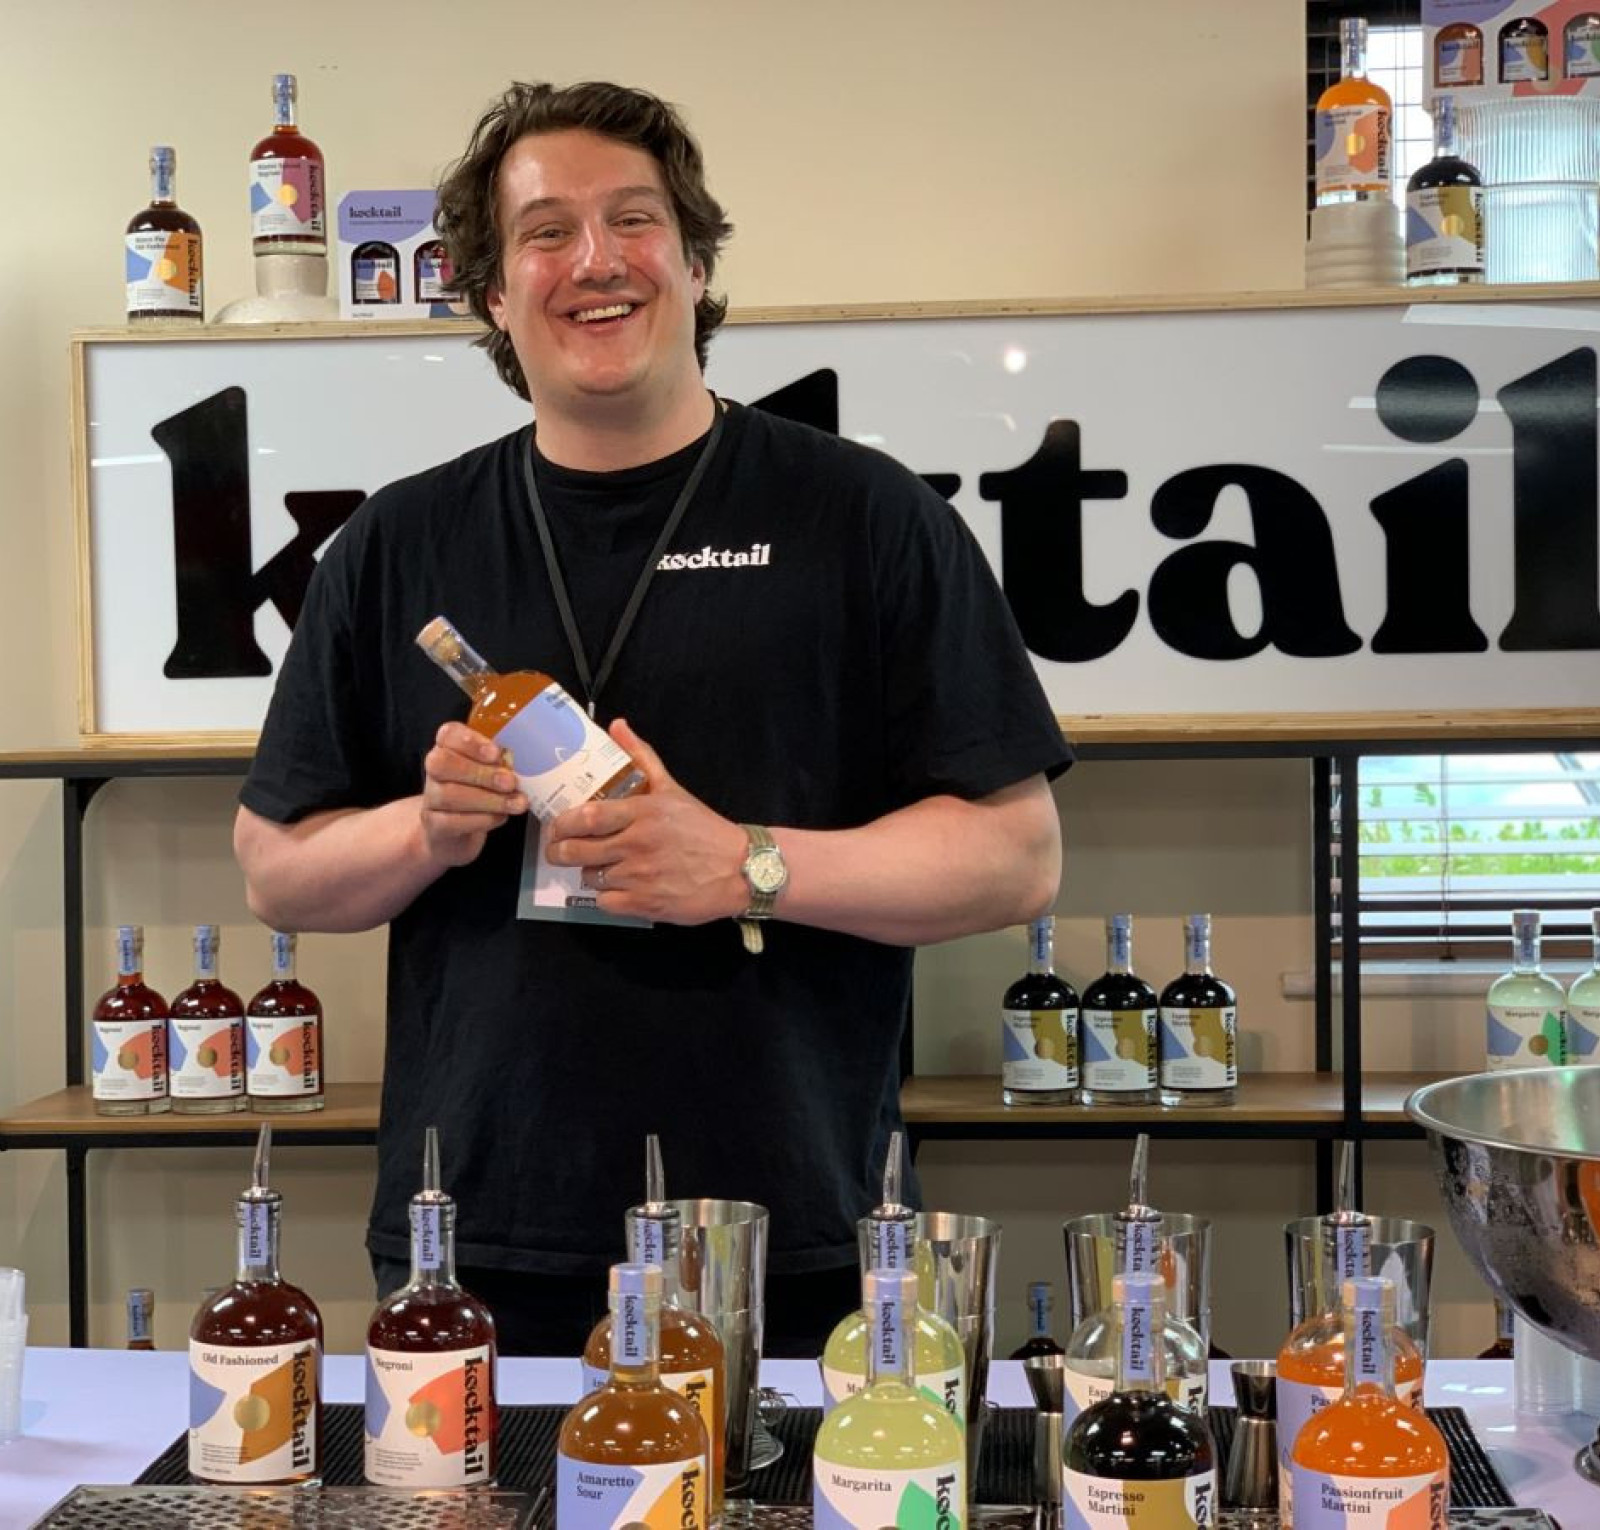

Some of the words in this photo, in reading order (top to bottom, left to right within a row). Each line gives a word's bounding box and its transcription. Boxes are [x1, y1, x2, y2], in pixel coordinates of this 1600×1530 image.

[203, 1351, 218, 1364] Old
[220, 1353, 279, 1367] Fashioned
[376, 1357, 414, 1371] Negroni
[577, 1471, 635, 1488] Amaretto
[832, 1474, 892, 1493] Margarita
[577, 1486, 604, 1500] Sour
[1088, 1485, 1146, 1502] Espresso
[1321, 1483, 1404, 1500] Passionfruit
[1088, 1499, 1136, 1516] Martini
[1321, 1497, 1371, 1514] Martini
